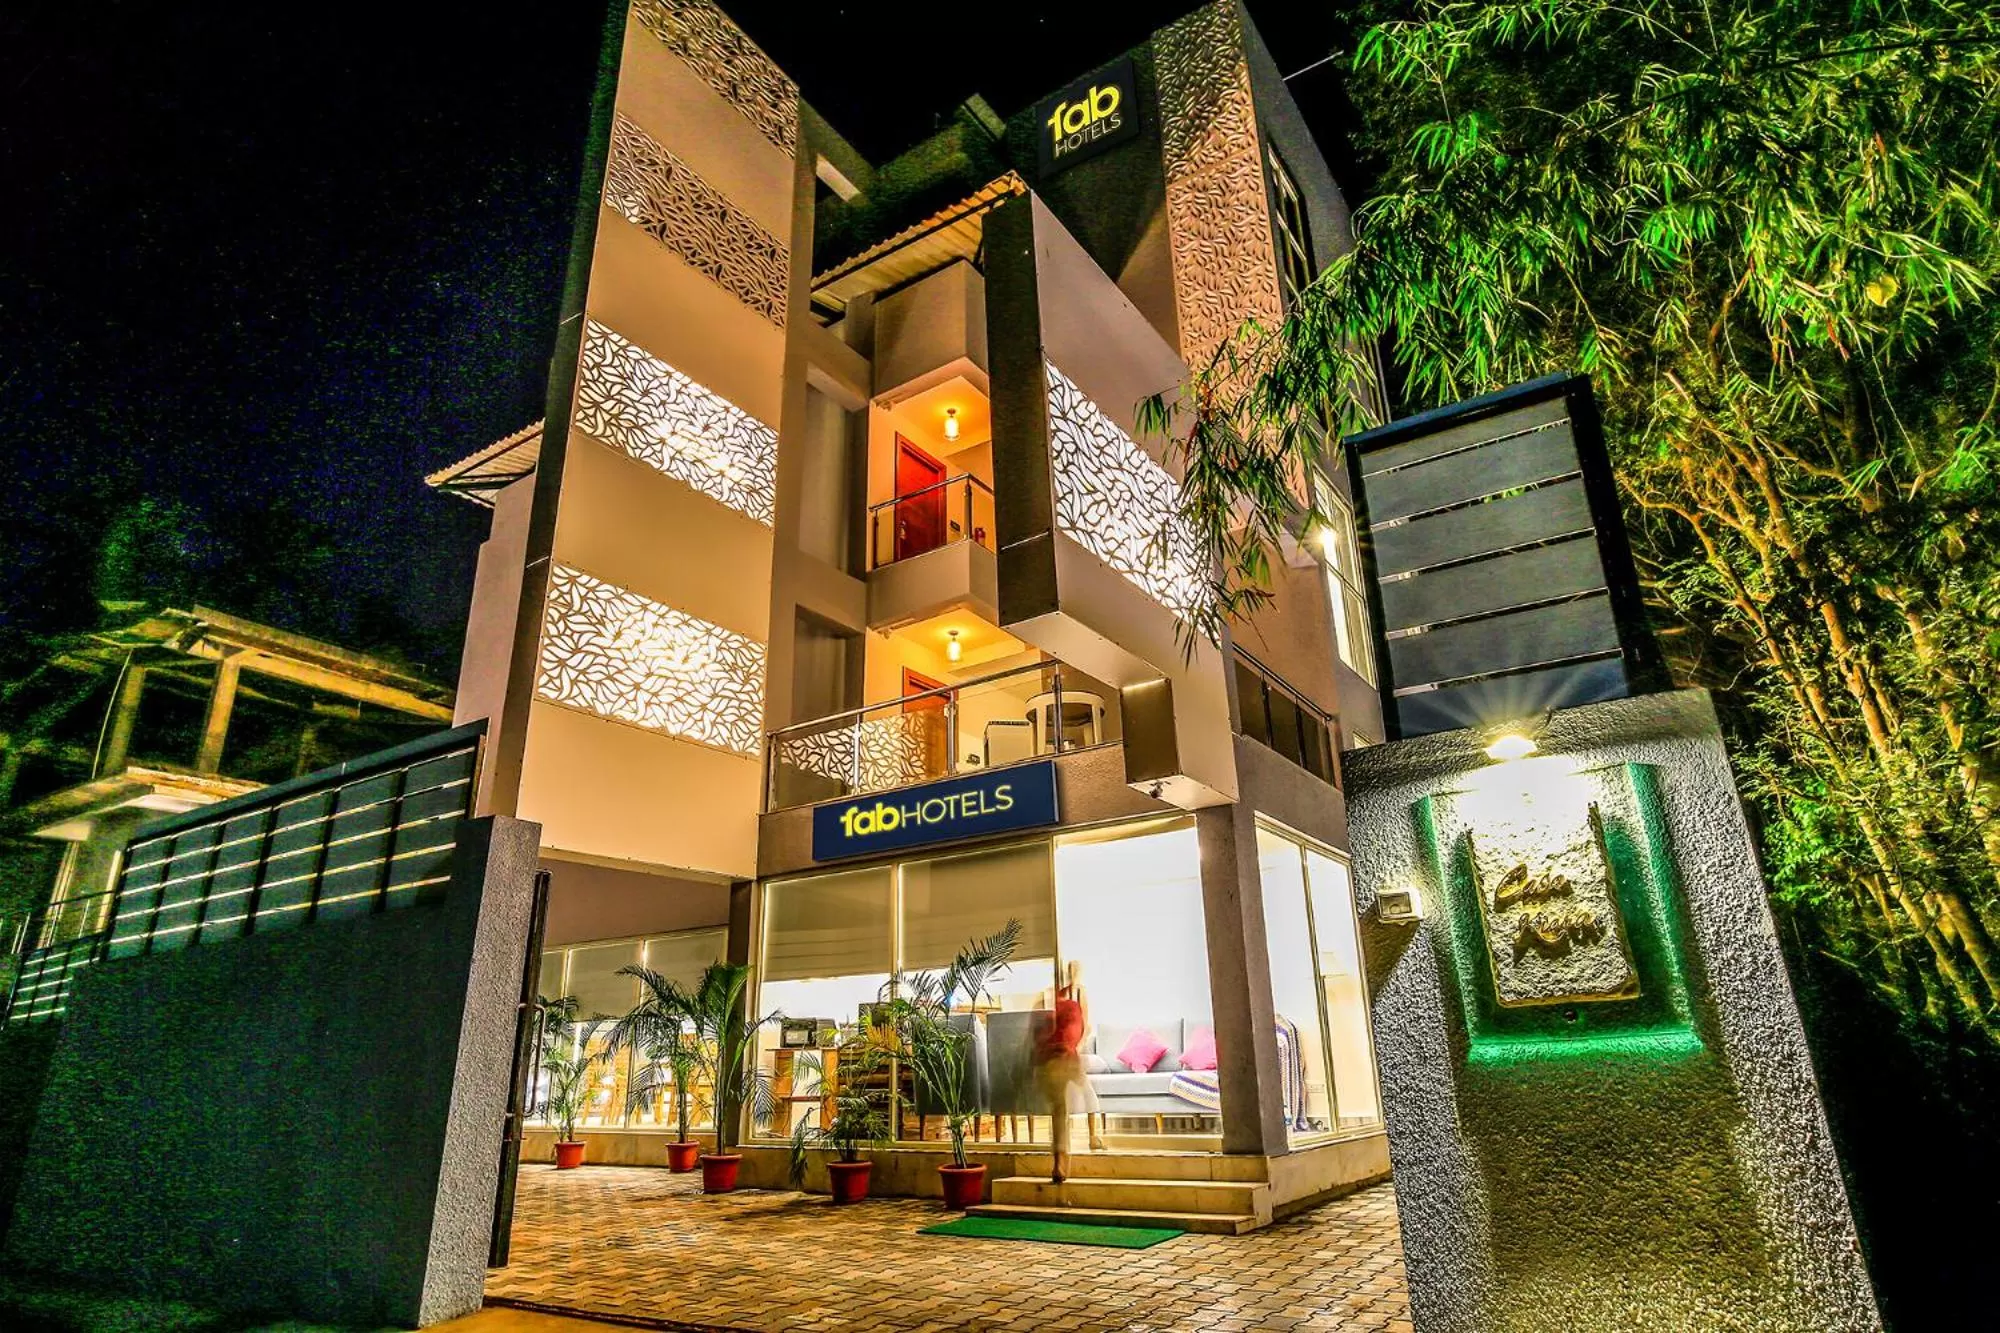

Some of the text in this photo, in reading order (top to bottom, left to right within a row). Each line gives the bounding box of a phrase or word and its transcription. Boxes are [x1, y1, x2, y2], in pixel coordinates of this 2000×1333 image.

[1047, 85, 1120, 141] fab
[1055, 112, 1121, 157] HOTELS
[1495, 863, 1568, 906] Casa
